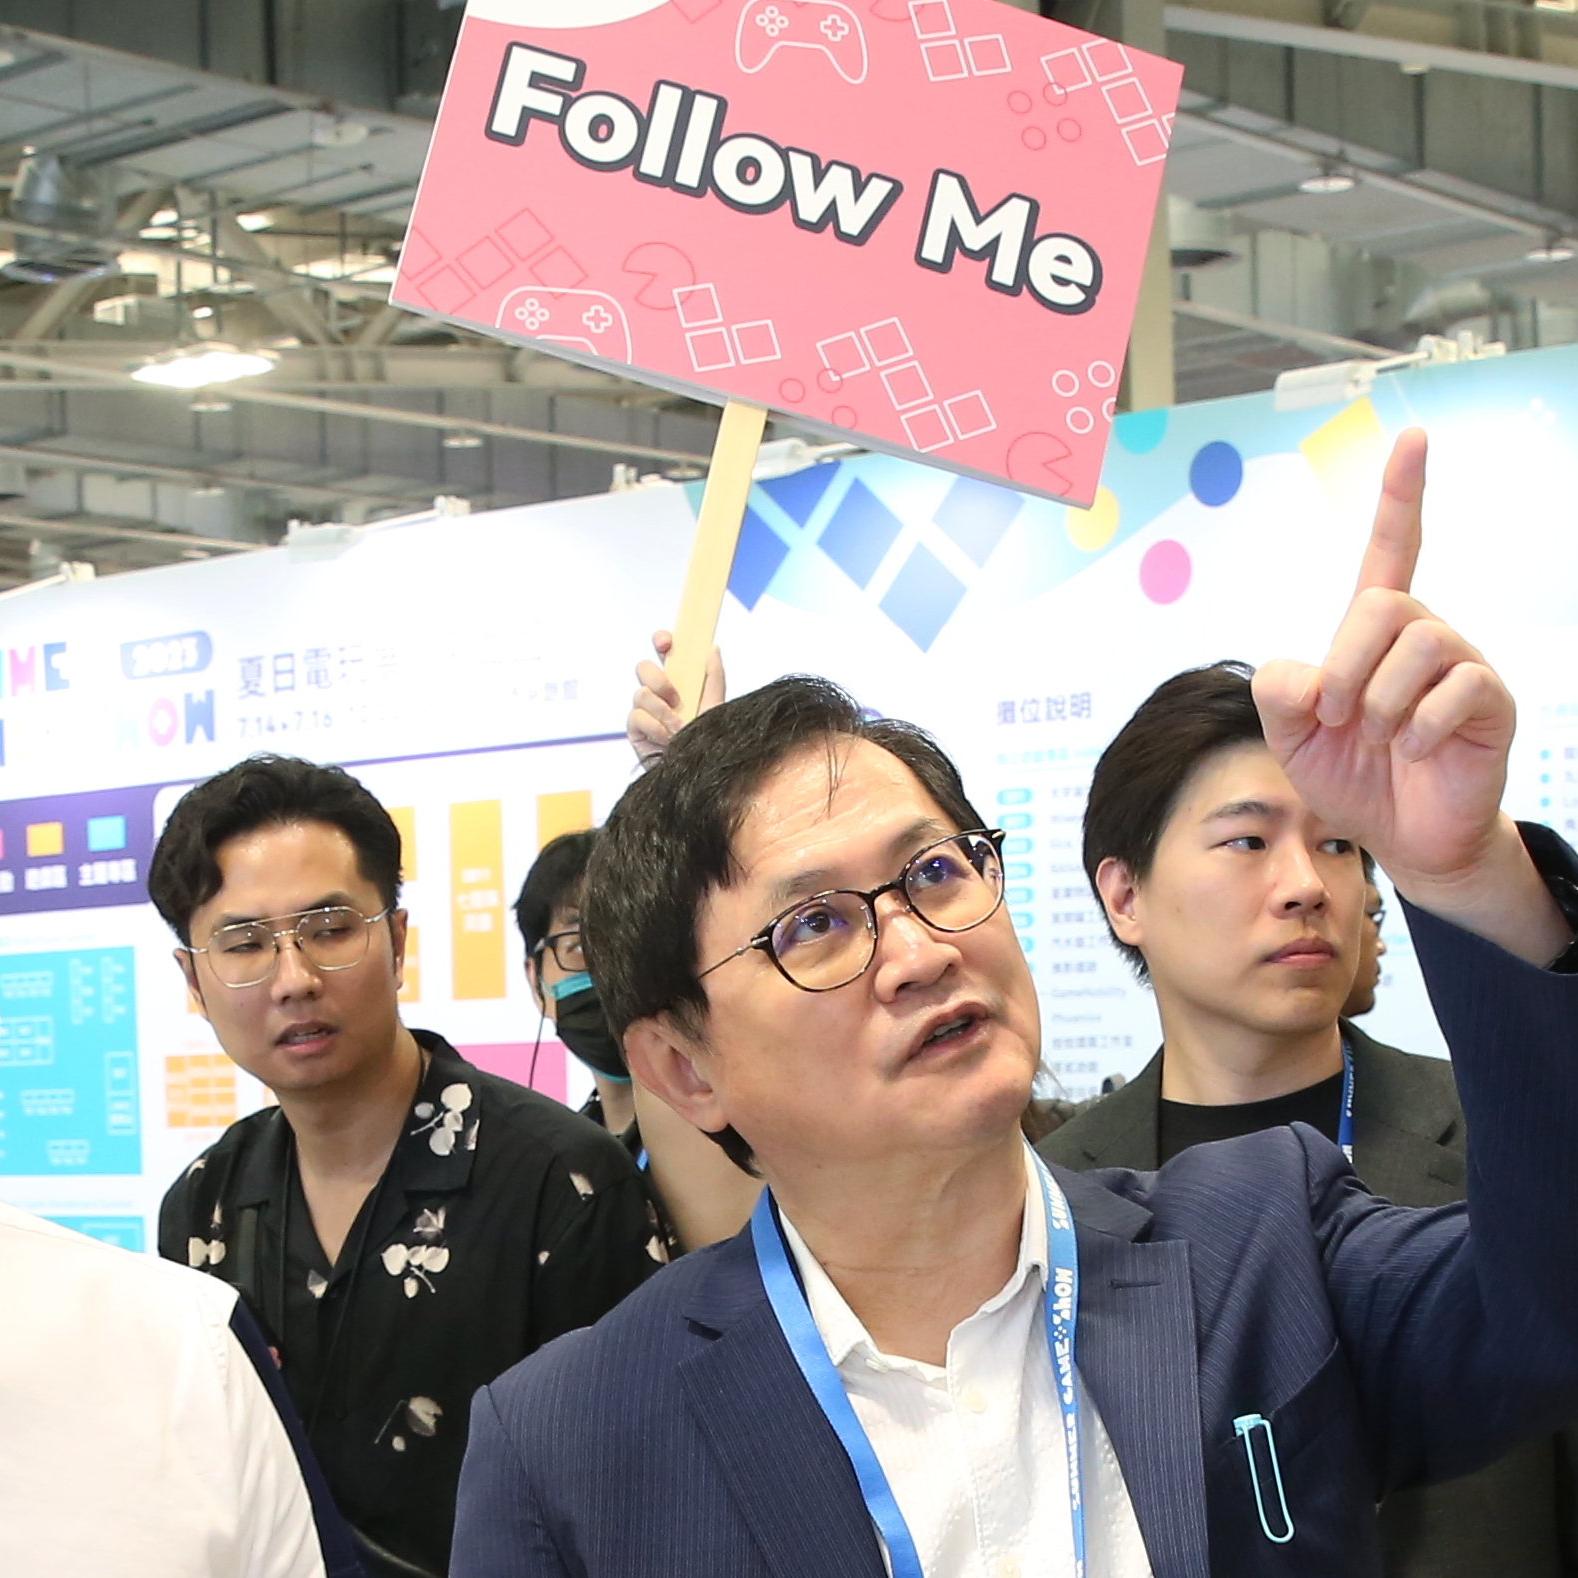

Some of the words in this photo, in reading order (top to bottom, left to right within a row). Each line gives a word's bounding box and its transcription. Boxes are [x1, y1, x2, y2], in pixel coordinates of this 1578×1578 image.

[486, 41, 902, 245] Follow
[916, 169, 1102, 314] Me
[131, 636, 201, 678] 2023
[237, 644, 399, 701] 夏日電玩
[1054, 1337, 1074, 1406] GAME
